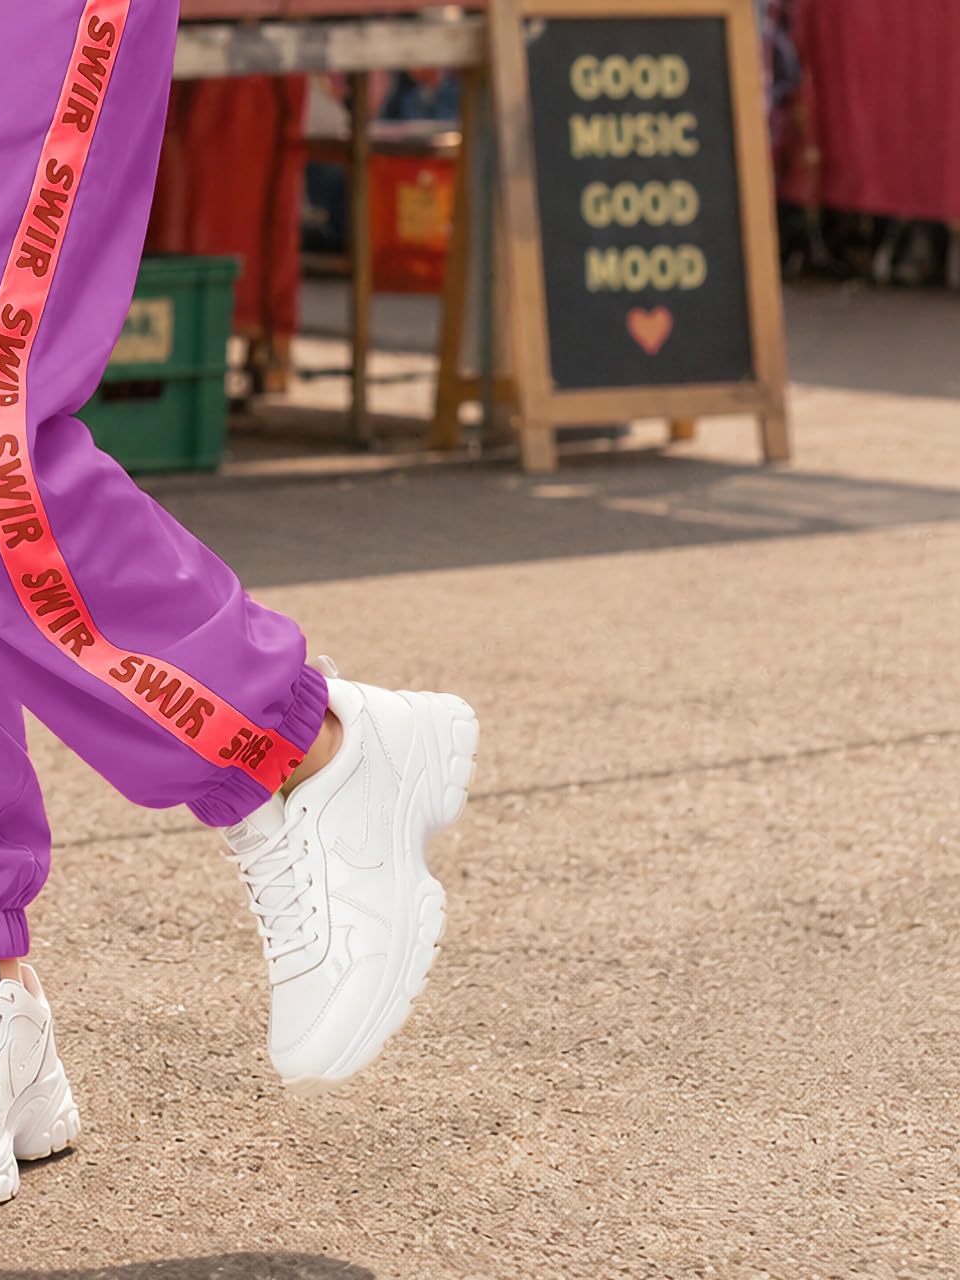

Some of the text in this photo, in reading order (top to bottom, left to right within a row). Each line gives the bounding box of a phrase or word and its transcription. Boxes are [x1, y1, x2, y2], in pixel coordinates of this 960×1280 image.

[61, 15, 116, 134] SWIR
[569, 53, 690, 101] GOOD
[568, 111, 700, 160] MUSIC
[16, 158, 75, 278] SWIR
[580, 179, 700, 229] GOOD
[584, 242, 708, 293] MOOD
[21, 568, 96, 658] SWIR
